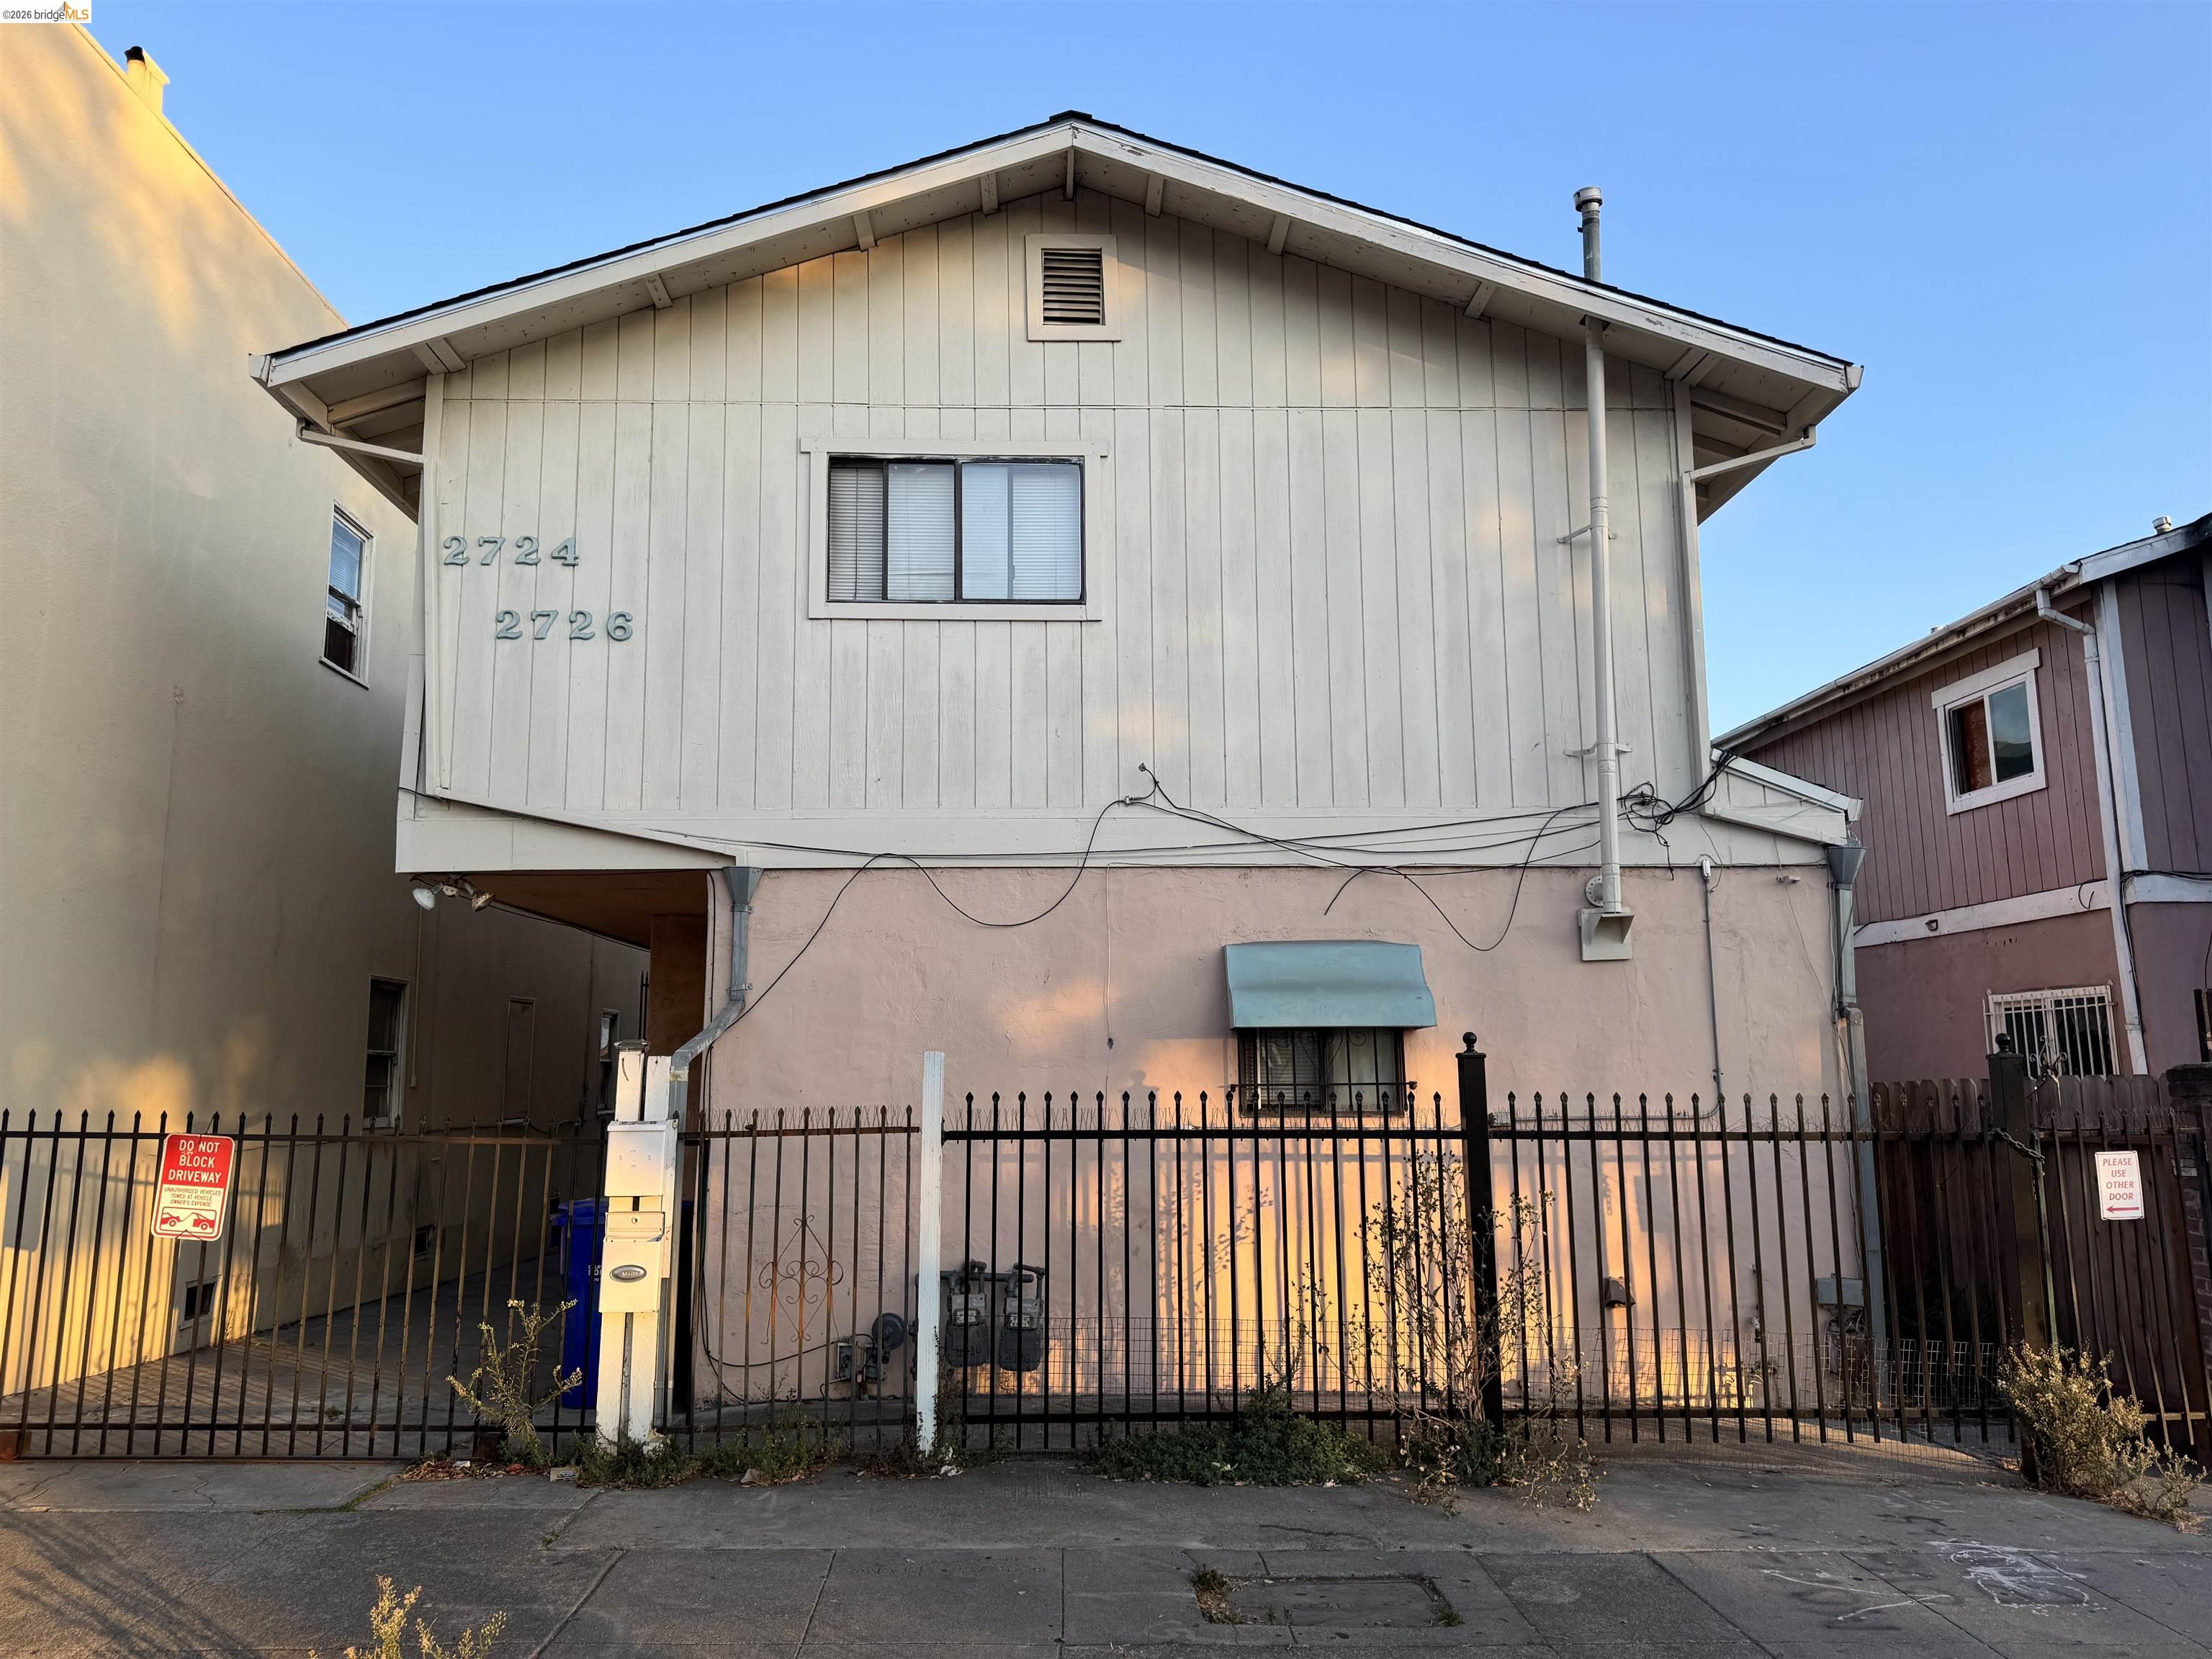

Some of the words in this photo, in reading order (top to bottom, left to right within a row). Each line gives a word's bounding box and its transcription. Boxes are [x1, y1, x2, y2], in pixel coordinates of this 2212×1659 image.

[444, 536, 579, 567] 2724
[496, 610, 633, 642] 2726
[179, 1140, 194, 1151] DO
[198, 1141, 220, 1153] NOT
[179, 1154, 215, 1168] BLOCK
[168, 1169, 222, 1183] DRIVEWAY
